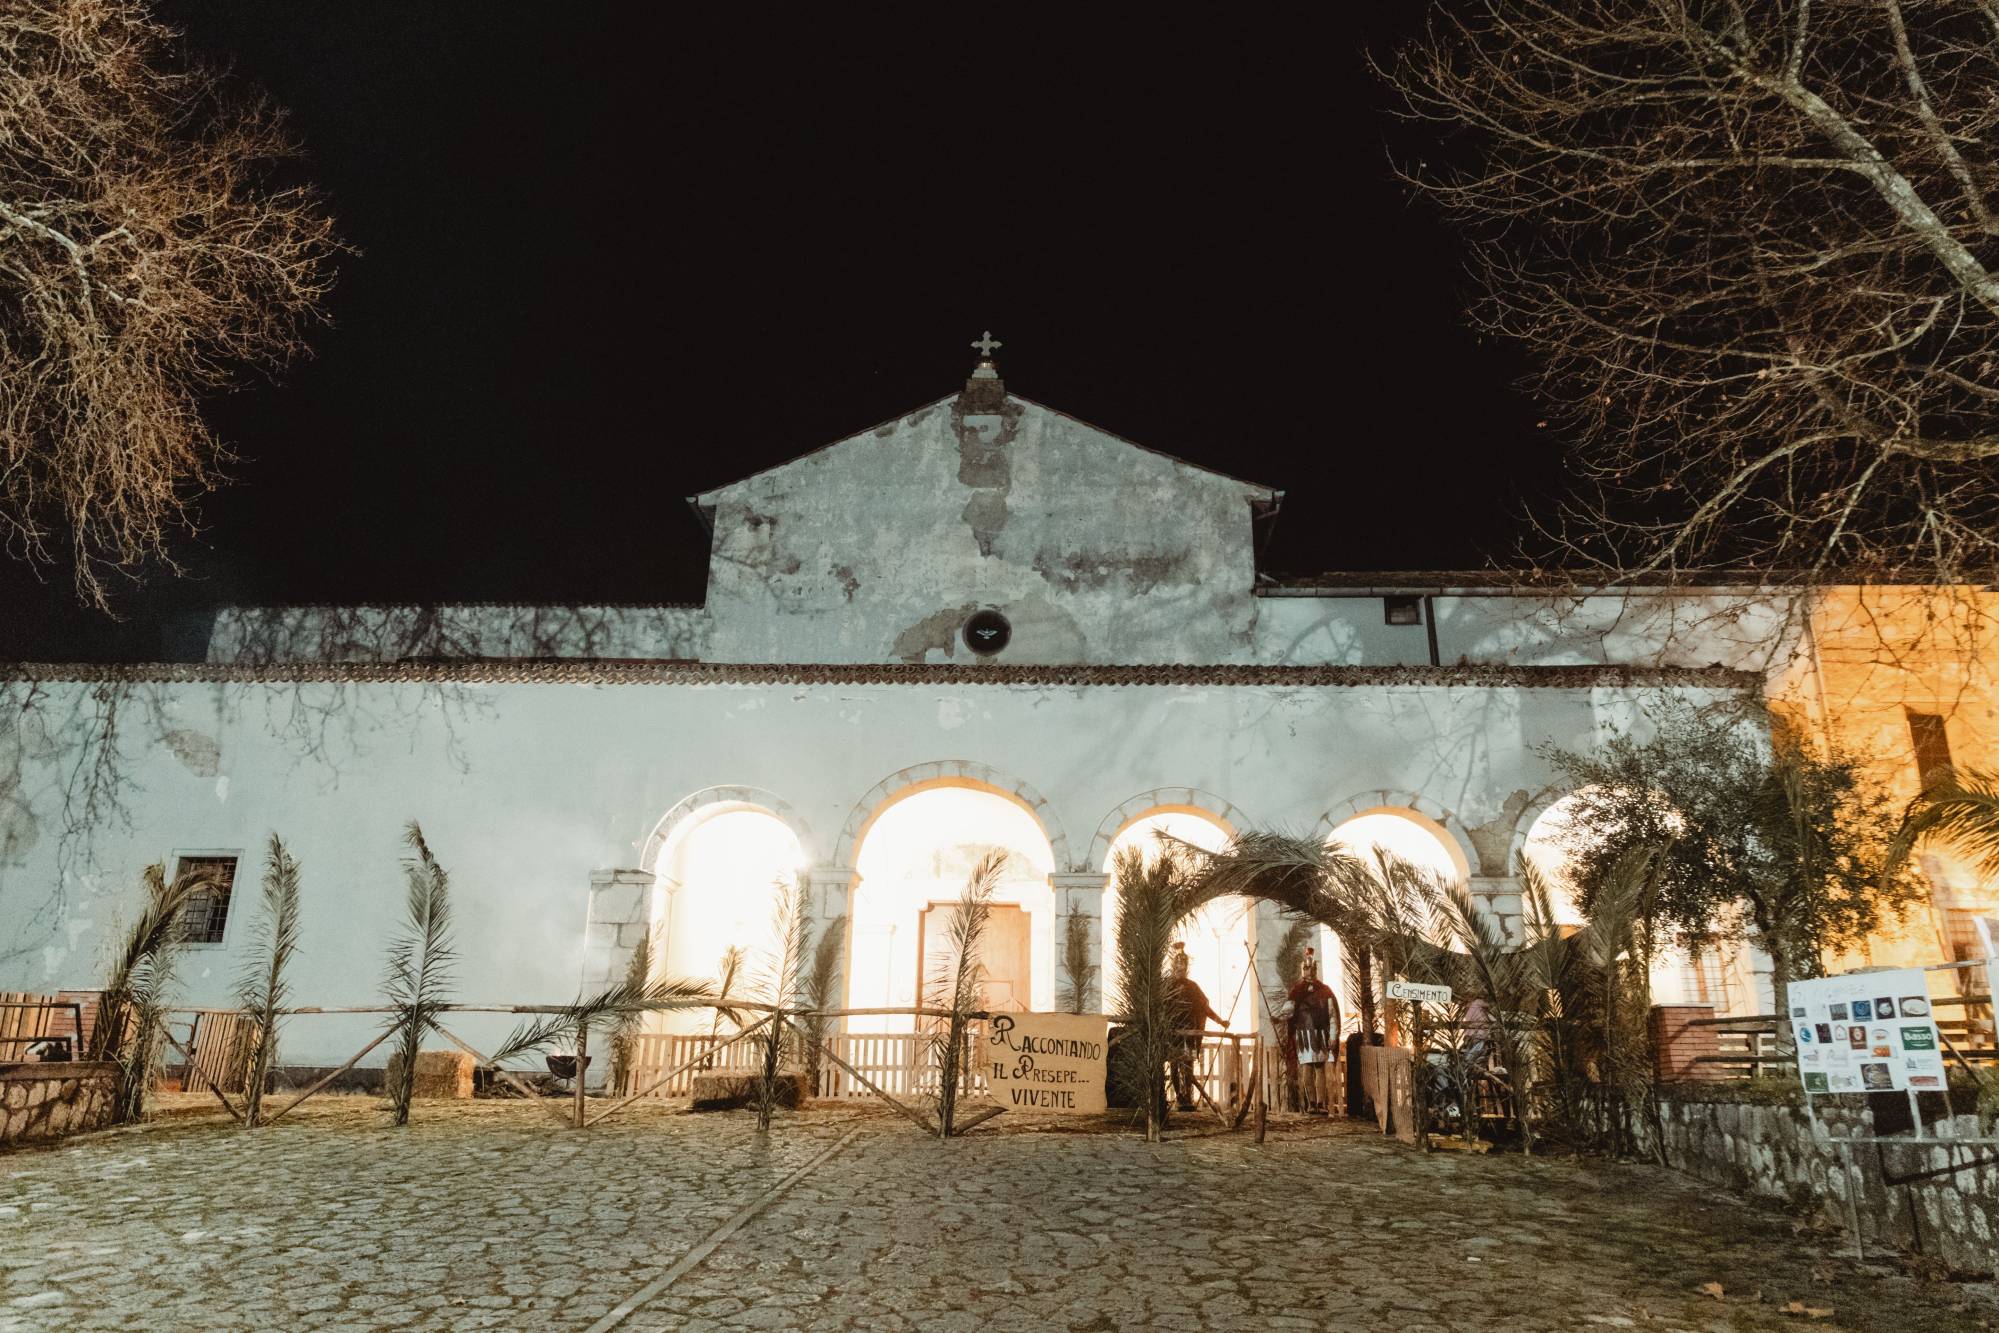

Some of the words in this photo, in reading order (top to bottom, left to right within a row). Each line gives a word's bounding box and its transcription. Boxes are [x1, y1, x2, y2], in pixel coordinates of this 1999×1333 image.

[1392, 983, 1448, 1001] CENSIMENTO
[991, 1015, 1101, 1060] RACCONTANDO
[993, 1062, 1008, 1080] IL
[1012, 1054, 1090, 1083] PRESEPE...
[1011, 1088, 1076, 1108] VIVENTE
